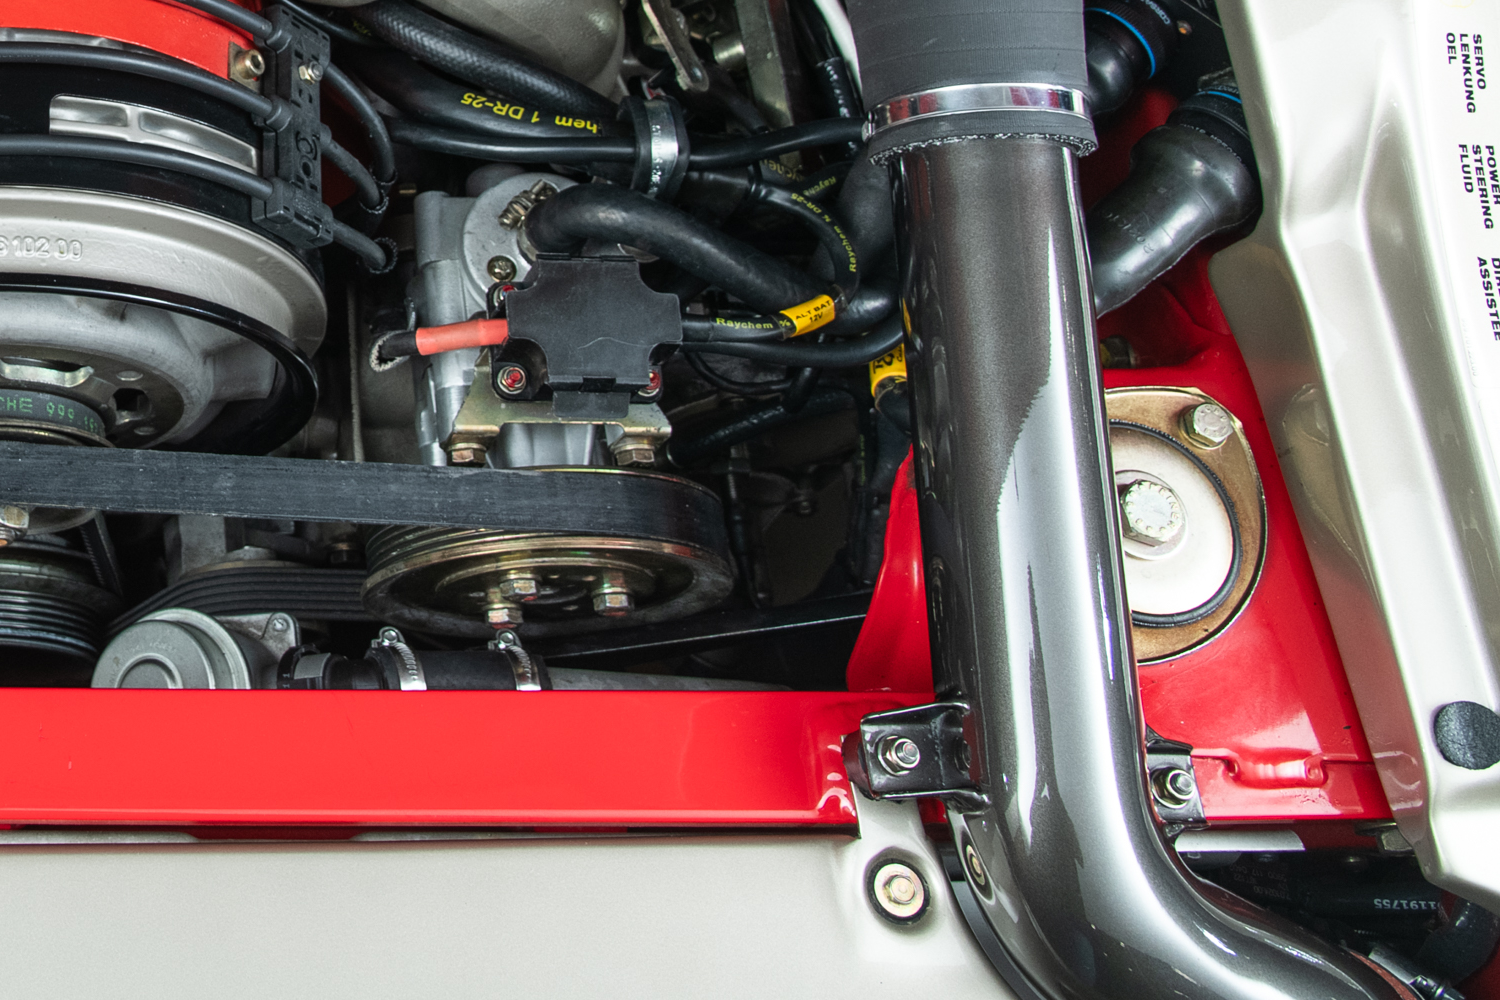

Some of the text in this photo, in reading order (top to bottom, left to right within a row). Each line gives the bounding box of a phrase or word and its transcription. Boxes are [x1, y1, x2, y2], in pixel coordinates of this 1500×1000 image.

[1446, 32, 1457, 64] OEL
[1472, 34, 1487, 90] SERVO
[1459, 33, 1476, 113] LENKUNG
[460, 92, 525, 120] DR-25
[1458, 144, 1474, 193] FLUID
[1485, 145, 1500, 205] POWER
[791, 193, 822, 213] DR-25
[1472, 144, 1494, 230] STEERING
[11, 235, 51, 257] 102
[834, 226, 857, 272] Raychem
[716, 317, 773, 329] Raychem
[795, 300, 831, 320] ALT BAT
[809, 312, 824, 324] 12V
